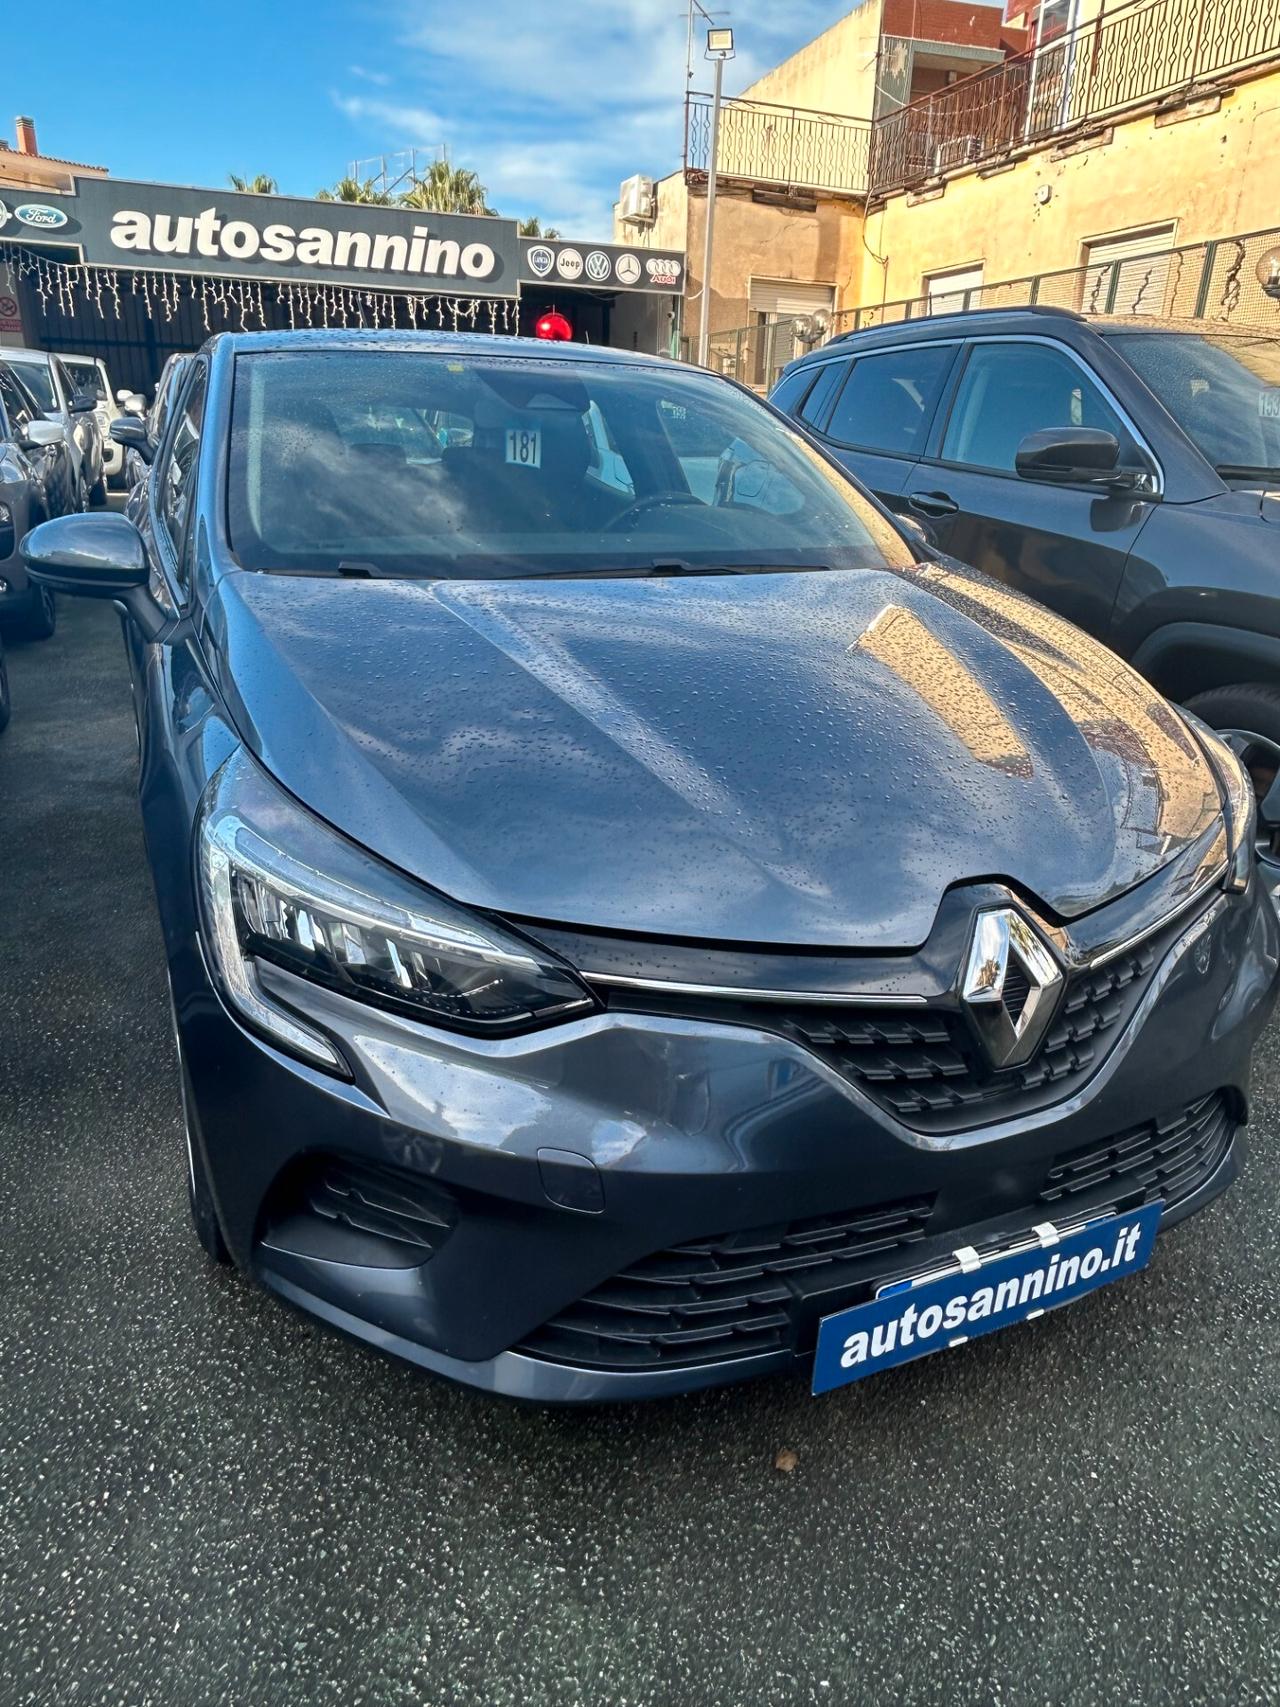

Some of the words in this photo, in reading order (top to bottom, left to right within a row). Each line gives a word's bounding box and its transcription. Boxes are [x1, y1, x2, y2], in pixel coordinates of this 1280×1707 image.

[26, 208, 57, 225] Ford
[110, 207, 495, 278] autosannino
[560, 258, 580, 269] Jeep
[510, 431, 537, 465] 181
[840, 1223, 1142, 1369] autosannino.it
